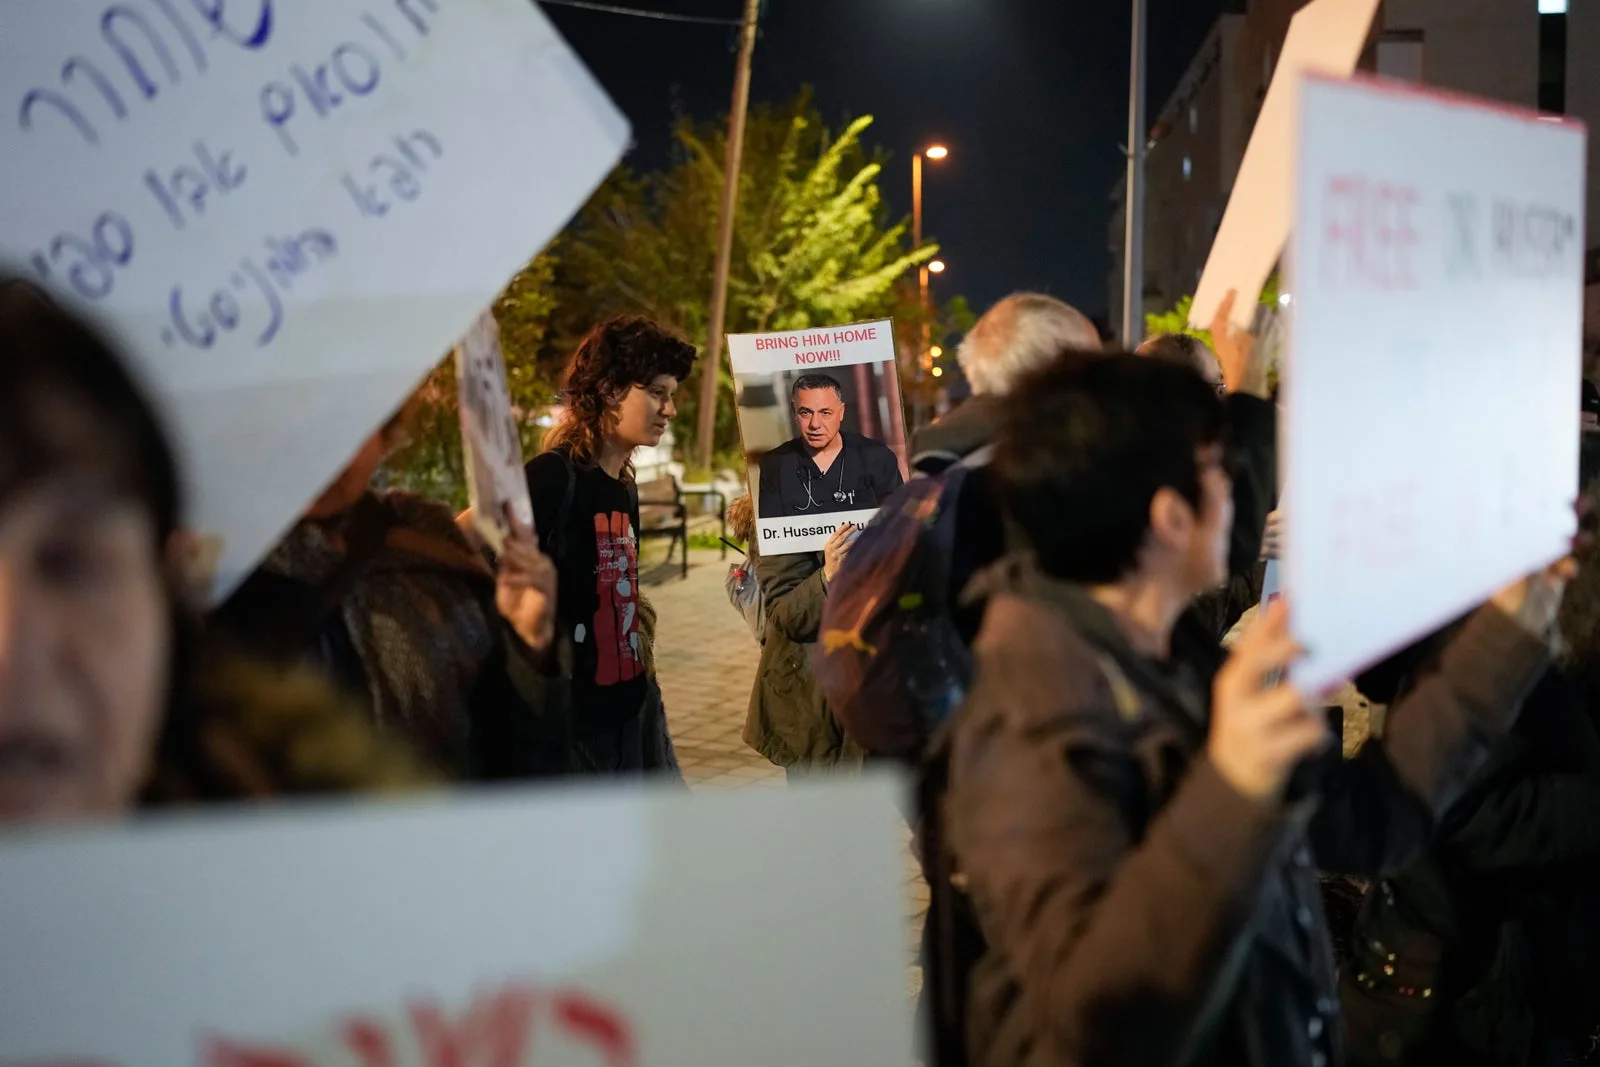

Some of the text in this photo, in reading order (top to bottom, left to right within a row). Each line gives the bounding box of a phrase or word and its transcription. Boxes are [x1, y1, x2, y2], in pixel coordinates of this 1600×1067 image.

[755, 327, 877, 351] BRING HIM HOME
[795, 349, 841, 365] NOW!!!
[763, 528, 780, 540] Dr.
[783, 524, 836, 538] Hussam
